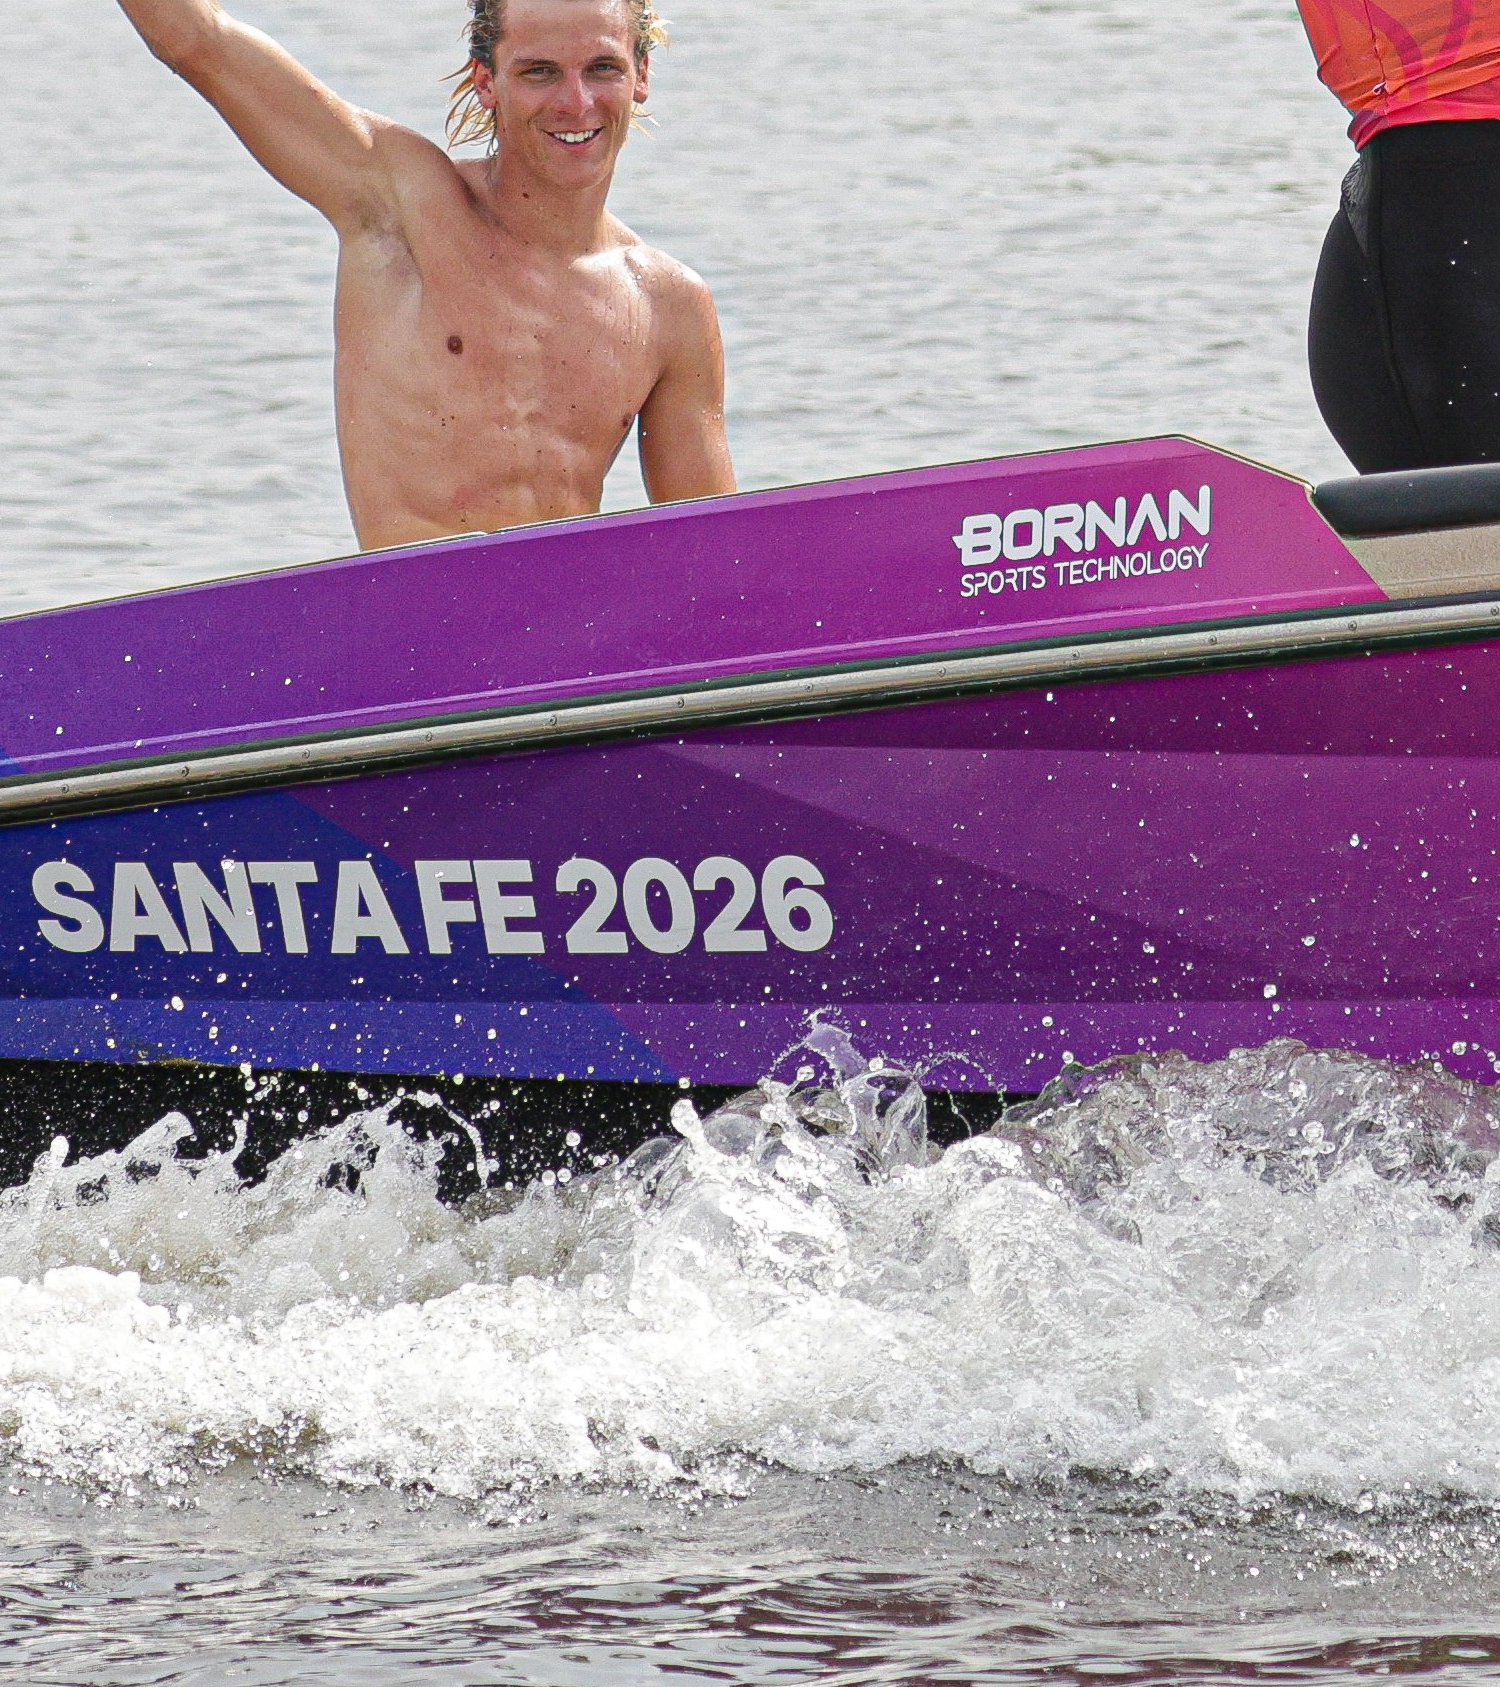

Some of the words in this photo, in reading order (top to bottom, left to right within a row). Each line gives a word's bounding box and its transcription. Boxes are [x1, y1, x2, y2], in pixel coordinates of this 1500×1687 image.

[952, 484, 1212, 567] BORNAN
[960, 565, 1047, 598] SPORTS
[1053, 542, 1210, 587] TECHNOLOGY
[31, 859, 411, 955] SANTA
[413, 858, 546, 955] FE
[554, 854, 836, 955] 2026
